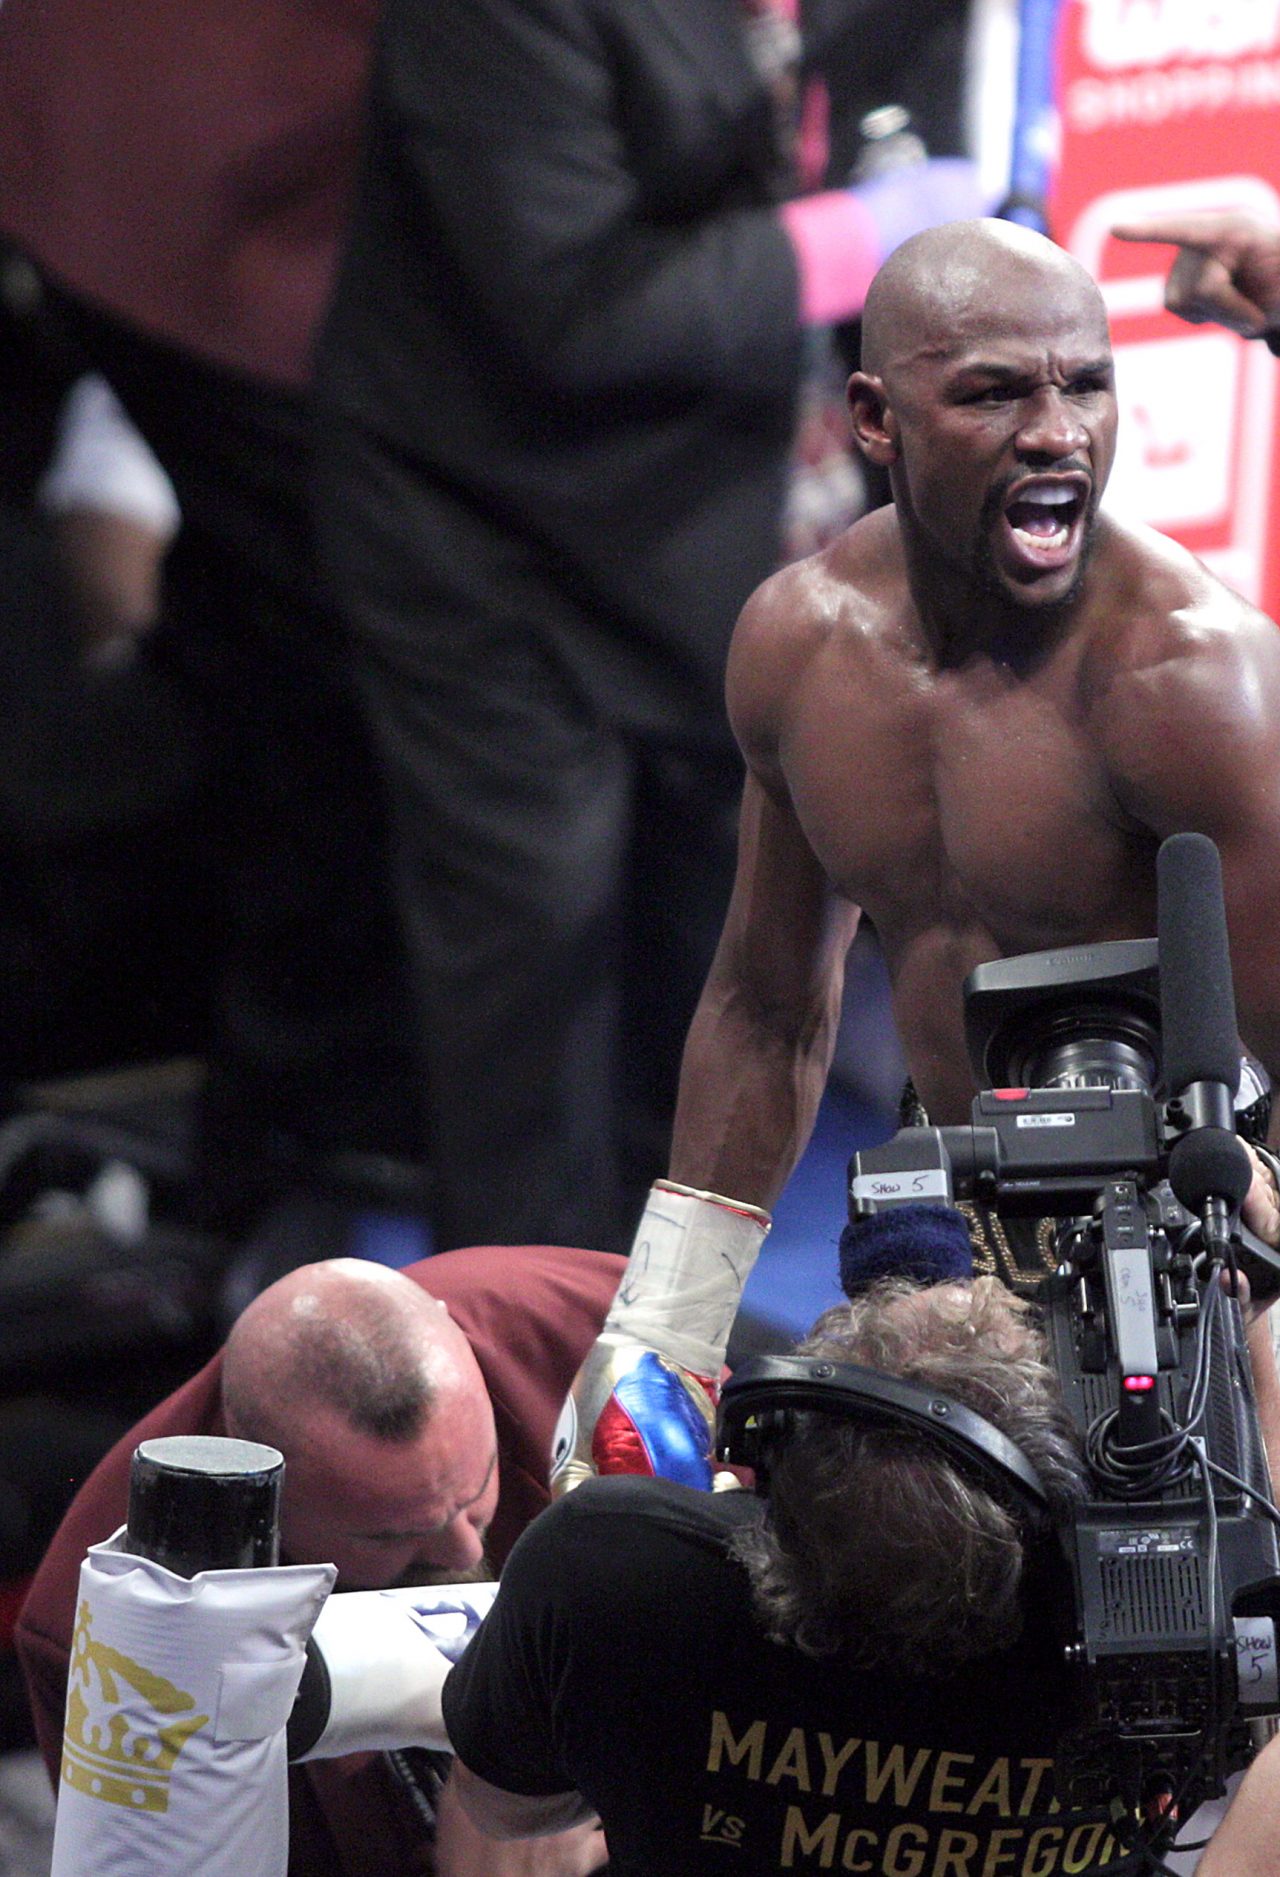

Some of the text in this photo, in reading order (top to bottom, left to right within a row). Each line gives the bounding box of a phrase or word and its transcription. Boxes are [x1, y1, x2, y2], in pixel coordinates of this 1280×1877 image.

[912, 1174, 930, 1193] 5
[1247, 1652, 1270, 1684] 5
[706, 1710, 1082, 1818] MAYWEAT
